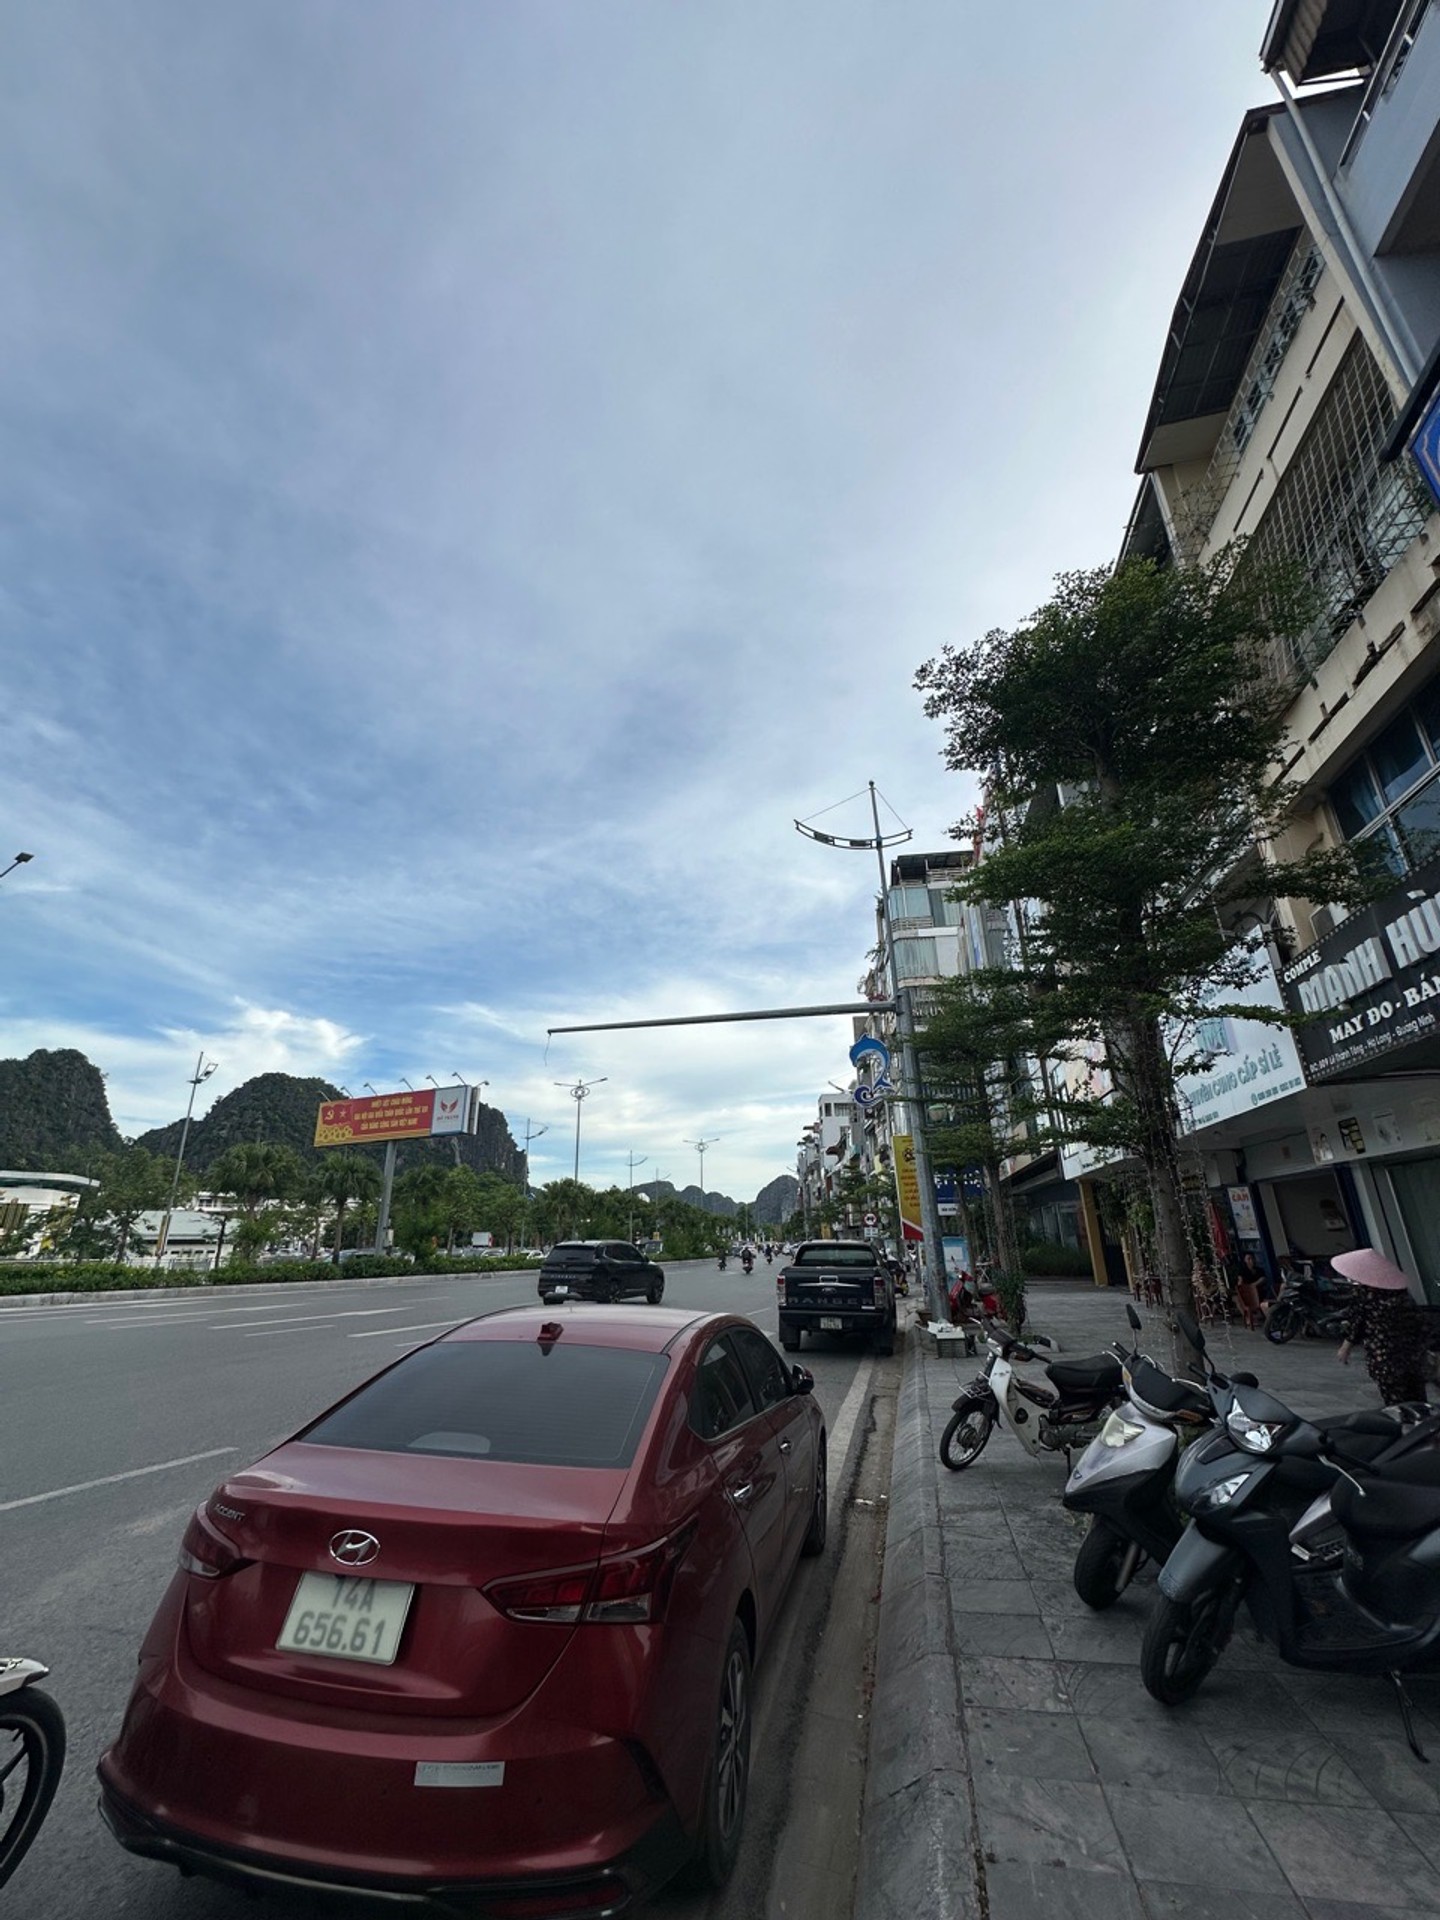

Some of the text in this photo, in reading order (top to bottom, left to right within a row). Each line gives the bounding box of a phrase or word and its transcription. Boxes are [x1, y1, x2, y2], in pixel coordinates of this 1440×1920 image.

[1284, 950, 1322, 983] COMPLE
[1298, 889, 1440, 1015] MẠNH HÙ
[1329, 1014, 1364, 1044] MAY
[1366, 1001, 1393, 1026] ĐO
[1237, 1054, 1258, 1085] CẤP
[332, 1577, 376, 1613] 14A
[292, 1610, 386, 1656] 656.61
